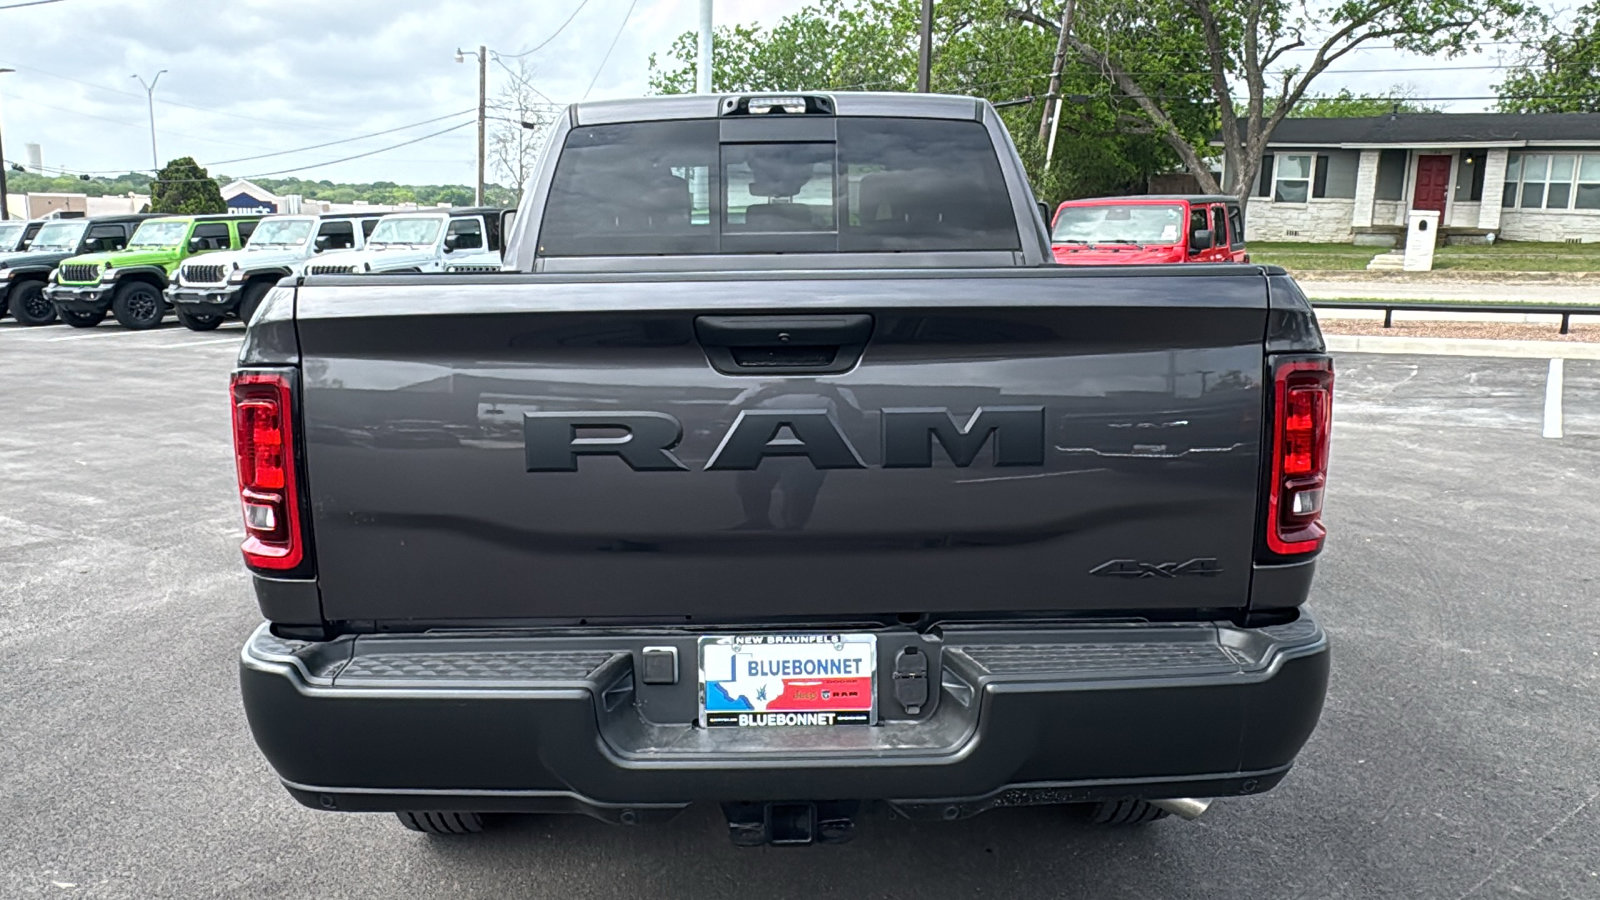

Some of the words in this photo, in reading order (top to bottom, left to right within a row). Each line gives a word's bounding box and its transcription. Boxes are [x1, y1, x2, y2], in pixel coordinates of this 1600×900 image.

[523, 406, 1046, 472] RAM
[736, 636, 764, 644] NEW
[767, 635, 839, 644] BRAUNFELS
[748, 658, 863, 677] BLUEBONNET
[739, 713, 836, 726] BLUEBONNET
